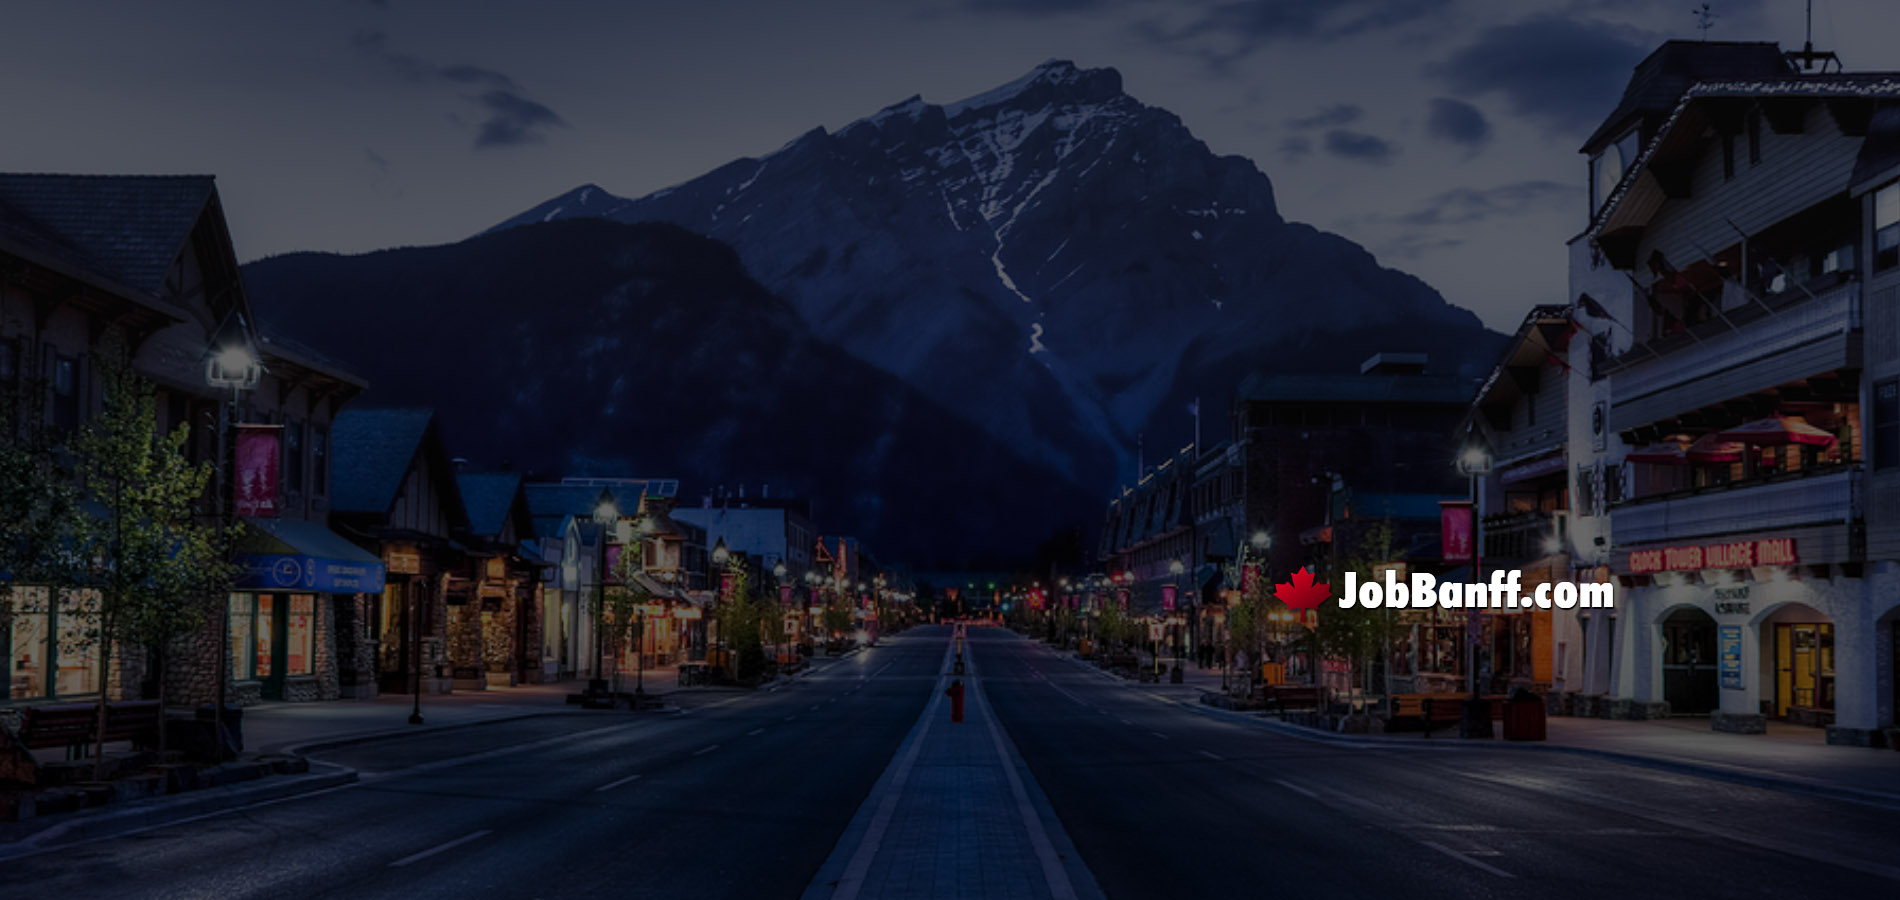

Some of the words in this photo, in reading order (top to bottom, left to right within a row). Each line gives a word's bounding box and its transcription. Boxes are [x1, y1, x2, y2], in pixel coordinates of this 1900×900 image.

[1665, 545, 1702, 570] TOWER
[1705, 541, 1753, 569] VILLAGE
[1756, 538, 1795, 565] MALL
